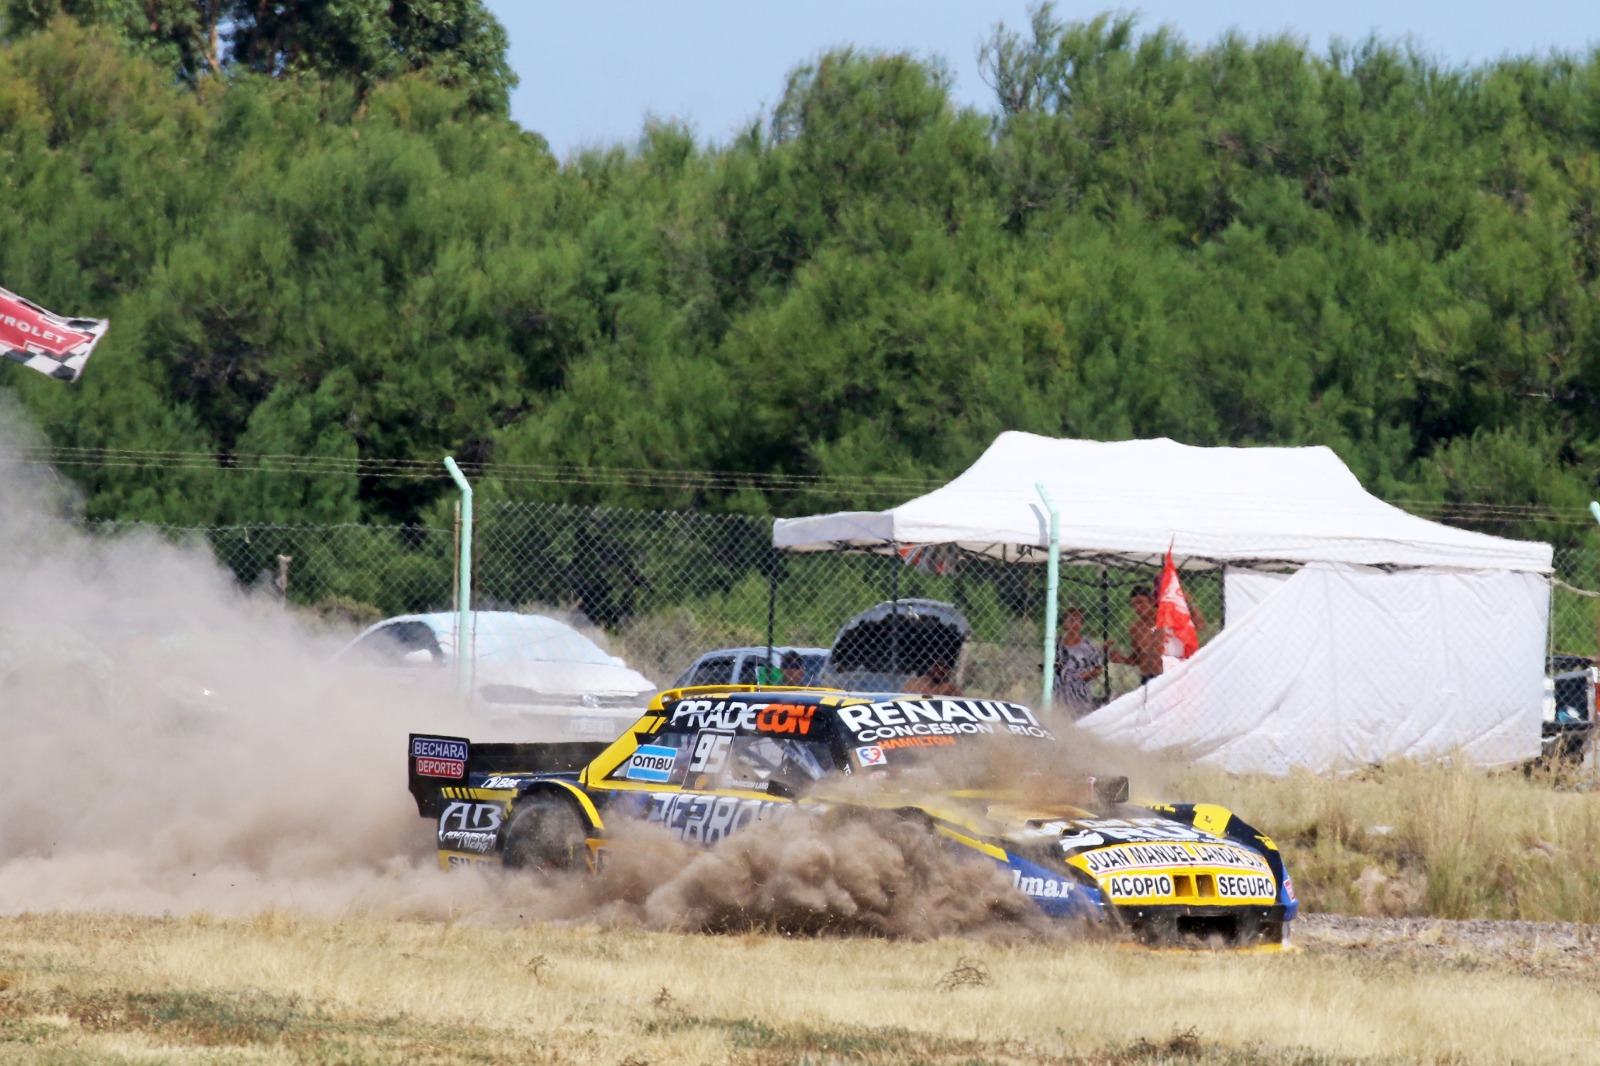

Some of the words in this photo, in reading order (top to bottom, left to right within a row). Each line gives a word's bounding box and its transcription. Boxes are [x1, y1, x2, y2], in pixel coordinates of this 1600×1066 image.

[670, 701, 817, 734] PRADECON
[837, 700, 1041, 732] RENAULT
[857, 721, 1056, 742] CONCESIONRIOS
[414, 742, 465, 759] BECHARA
[876, 735, 956, 750] HAMILTON
[632, 756, 673, 771] OMBU
[690, 734, 733, 773] 95
[418, 760, 462, 775] DEPORTES
[1084, 848, 1132, 871] JUAN
[1130, 845, 1196, 867] MANUEL
[1196, 845, 1241, 865] LANDA
[1111, 876, 1172, 896] ACOPIO
[1218, 875, 1275, 897] SEGURO
